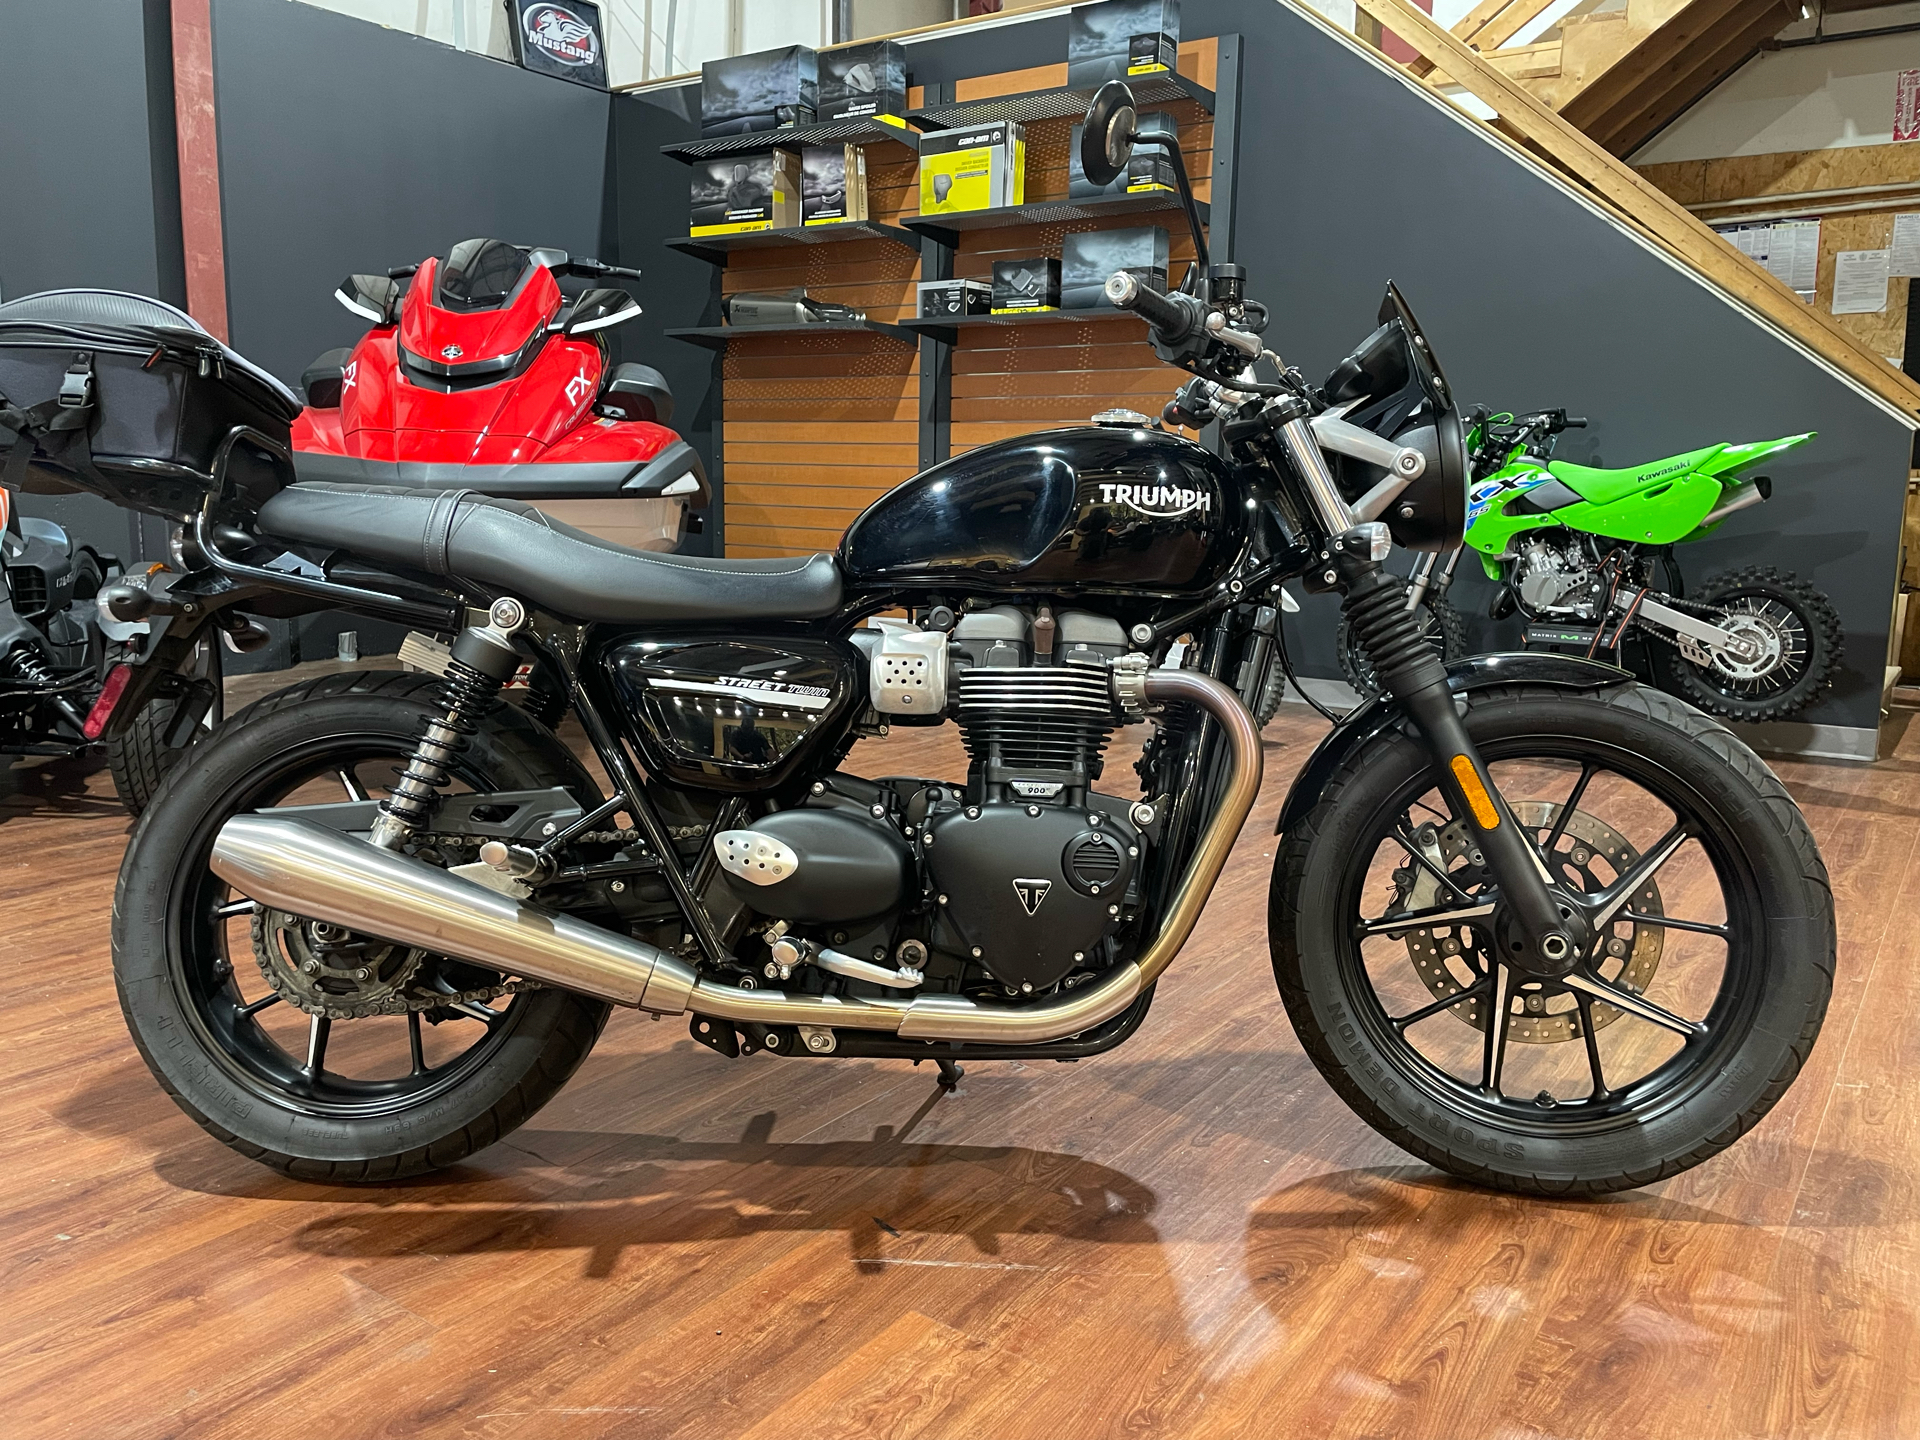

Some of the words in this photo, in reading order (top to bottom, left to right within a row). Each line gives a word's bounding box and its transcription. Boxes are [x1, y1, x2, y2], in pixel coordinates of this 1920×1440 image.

[529, 30, 595, 64] Mustang
[958, 135, 990, 146] can-am
[340, 361, 357, 395] FX
[565, 366, 592, 407] FX
[1637, 459, 1691, 483] Kawasaki
[1099, 484, 1211, 517] TRIUMPH
[714, 676, 786, 692] STREET
[787, 684, 831, 698] TWIN
[157, 1015, 254, 1120] PIRELLI
[1326, 1001, 1401, 1100] DEMON
[1407, 1103, 1525, 1160] SPORT
